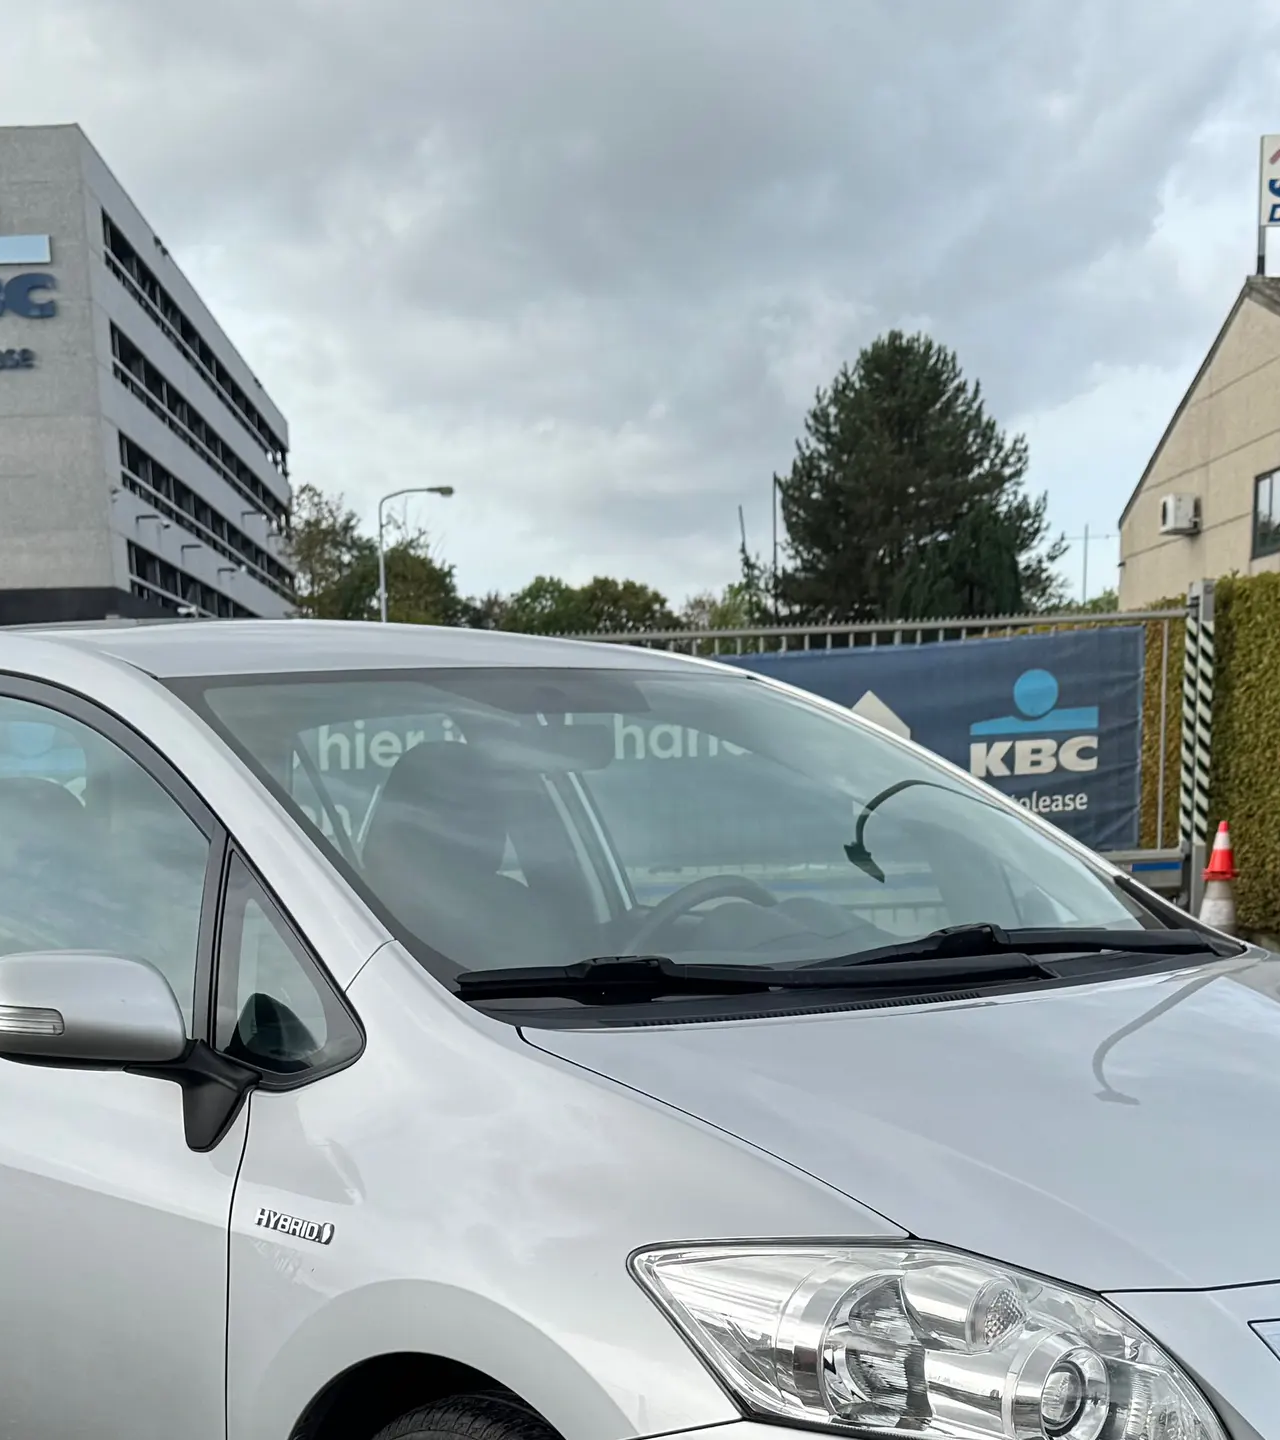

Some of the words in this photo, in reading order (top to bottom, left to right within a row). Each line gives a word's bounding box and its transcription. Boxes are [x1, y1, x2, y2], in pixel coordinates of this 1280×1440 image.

[319, 719, 424, 771] hier
[970, 735, 1099, 778] KBC
[1012, 790, 1089, 812] olease
[254, 1207, 322, 1243] HYBRID
